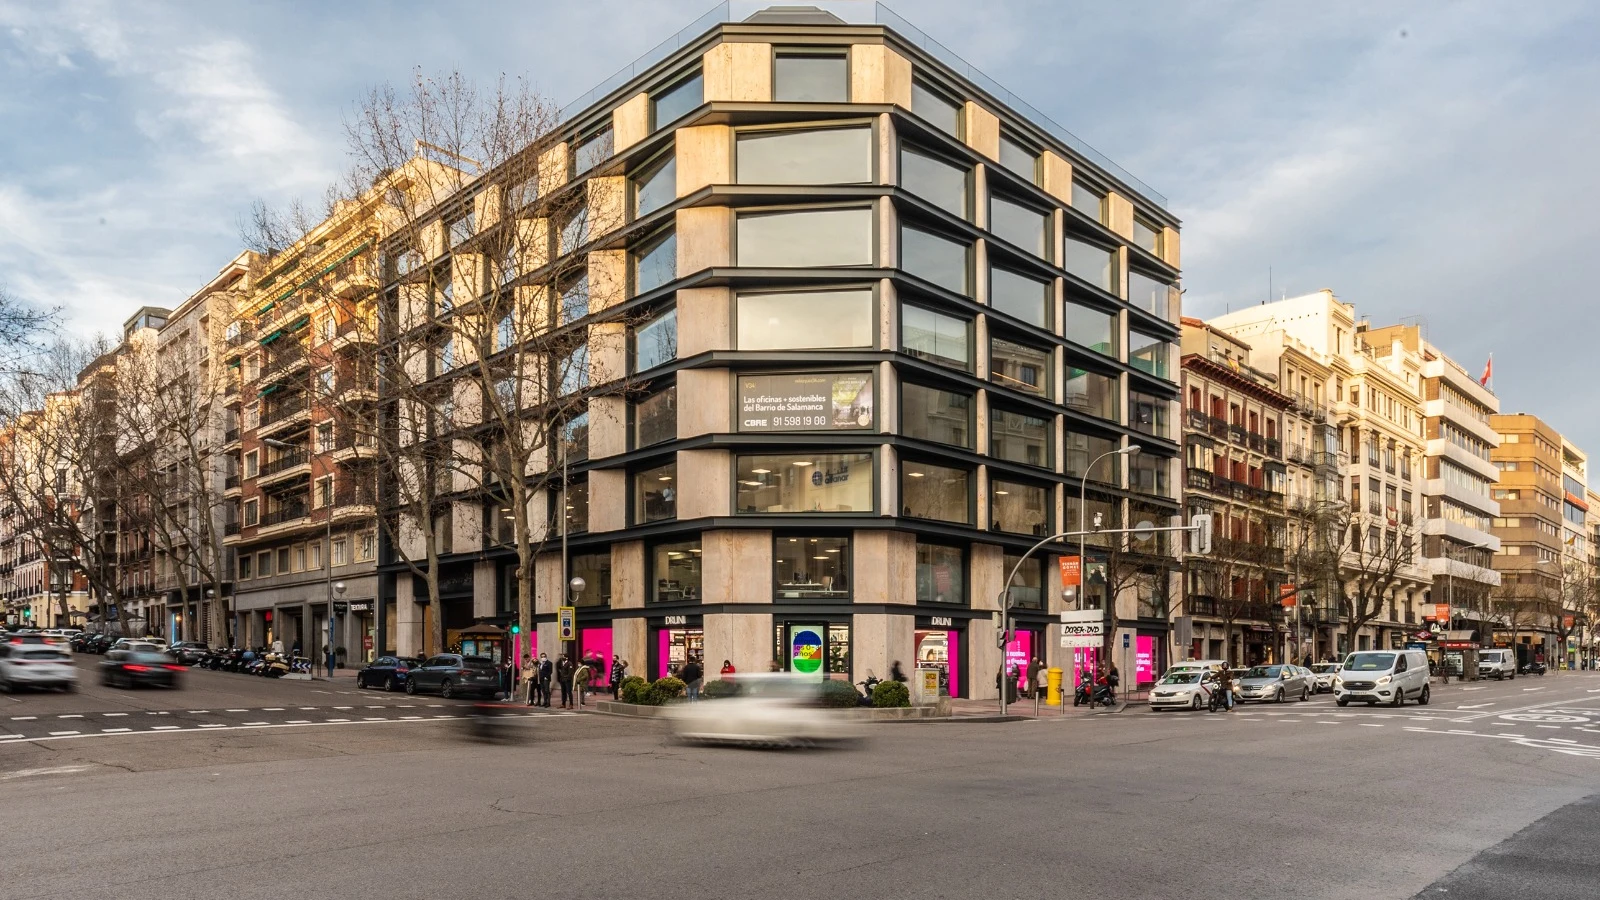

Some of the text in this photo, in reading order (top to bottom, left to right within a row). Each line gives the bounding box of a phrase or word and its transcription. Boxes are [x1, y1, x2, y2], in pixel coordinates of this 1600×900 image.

[743, 396, 756, 404] Las
[756, 395, 783, 403] oficinas
[788, 394, 826, 403] sostenibles
[743, 402, 824, 412] del Barrio de Salamanca
[744, 419, 768, 427] CBRE
[773, 415, 826, 426] 91 598 19 00
[825, 474, 849, 485] alfanar
[665, 615, 687, 625] DRUNI
[932, 616, 952, 626] DRUNI
